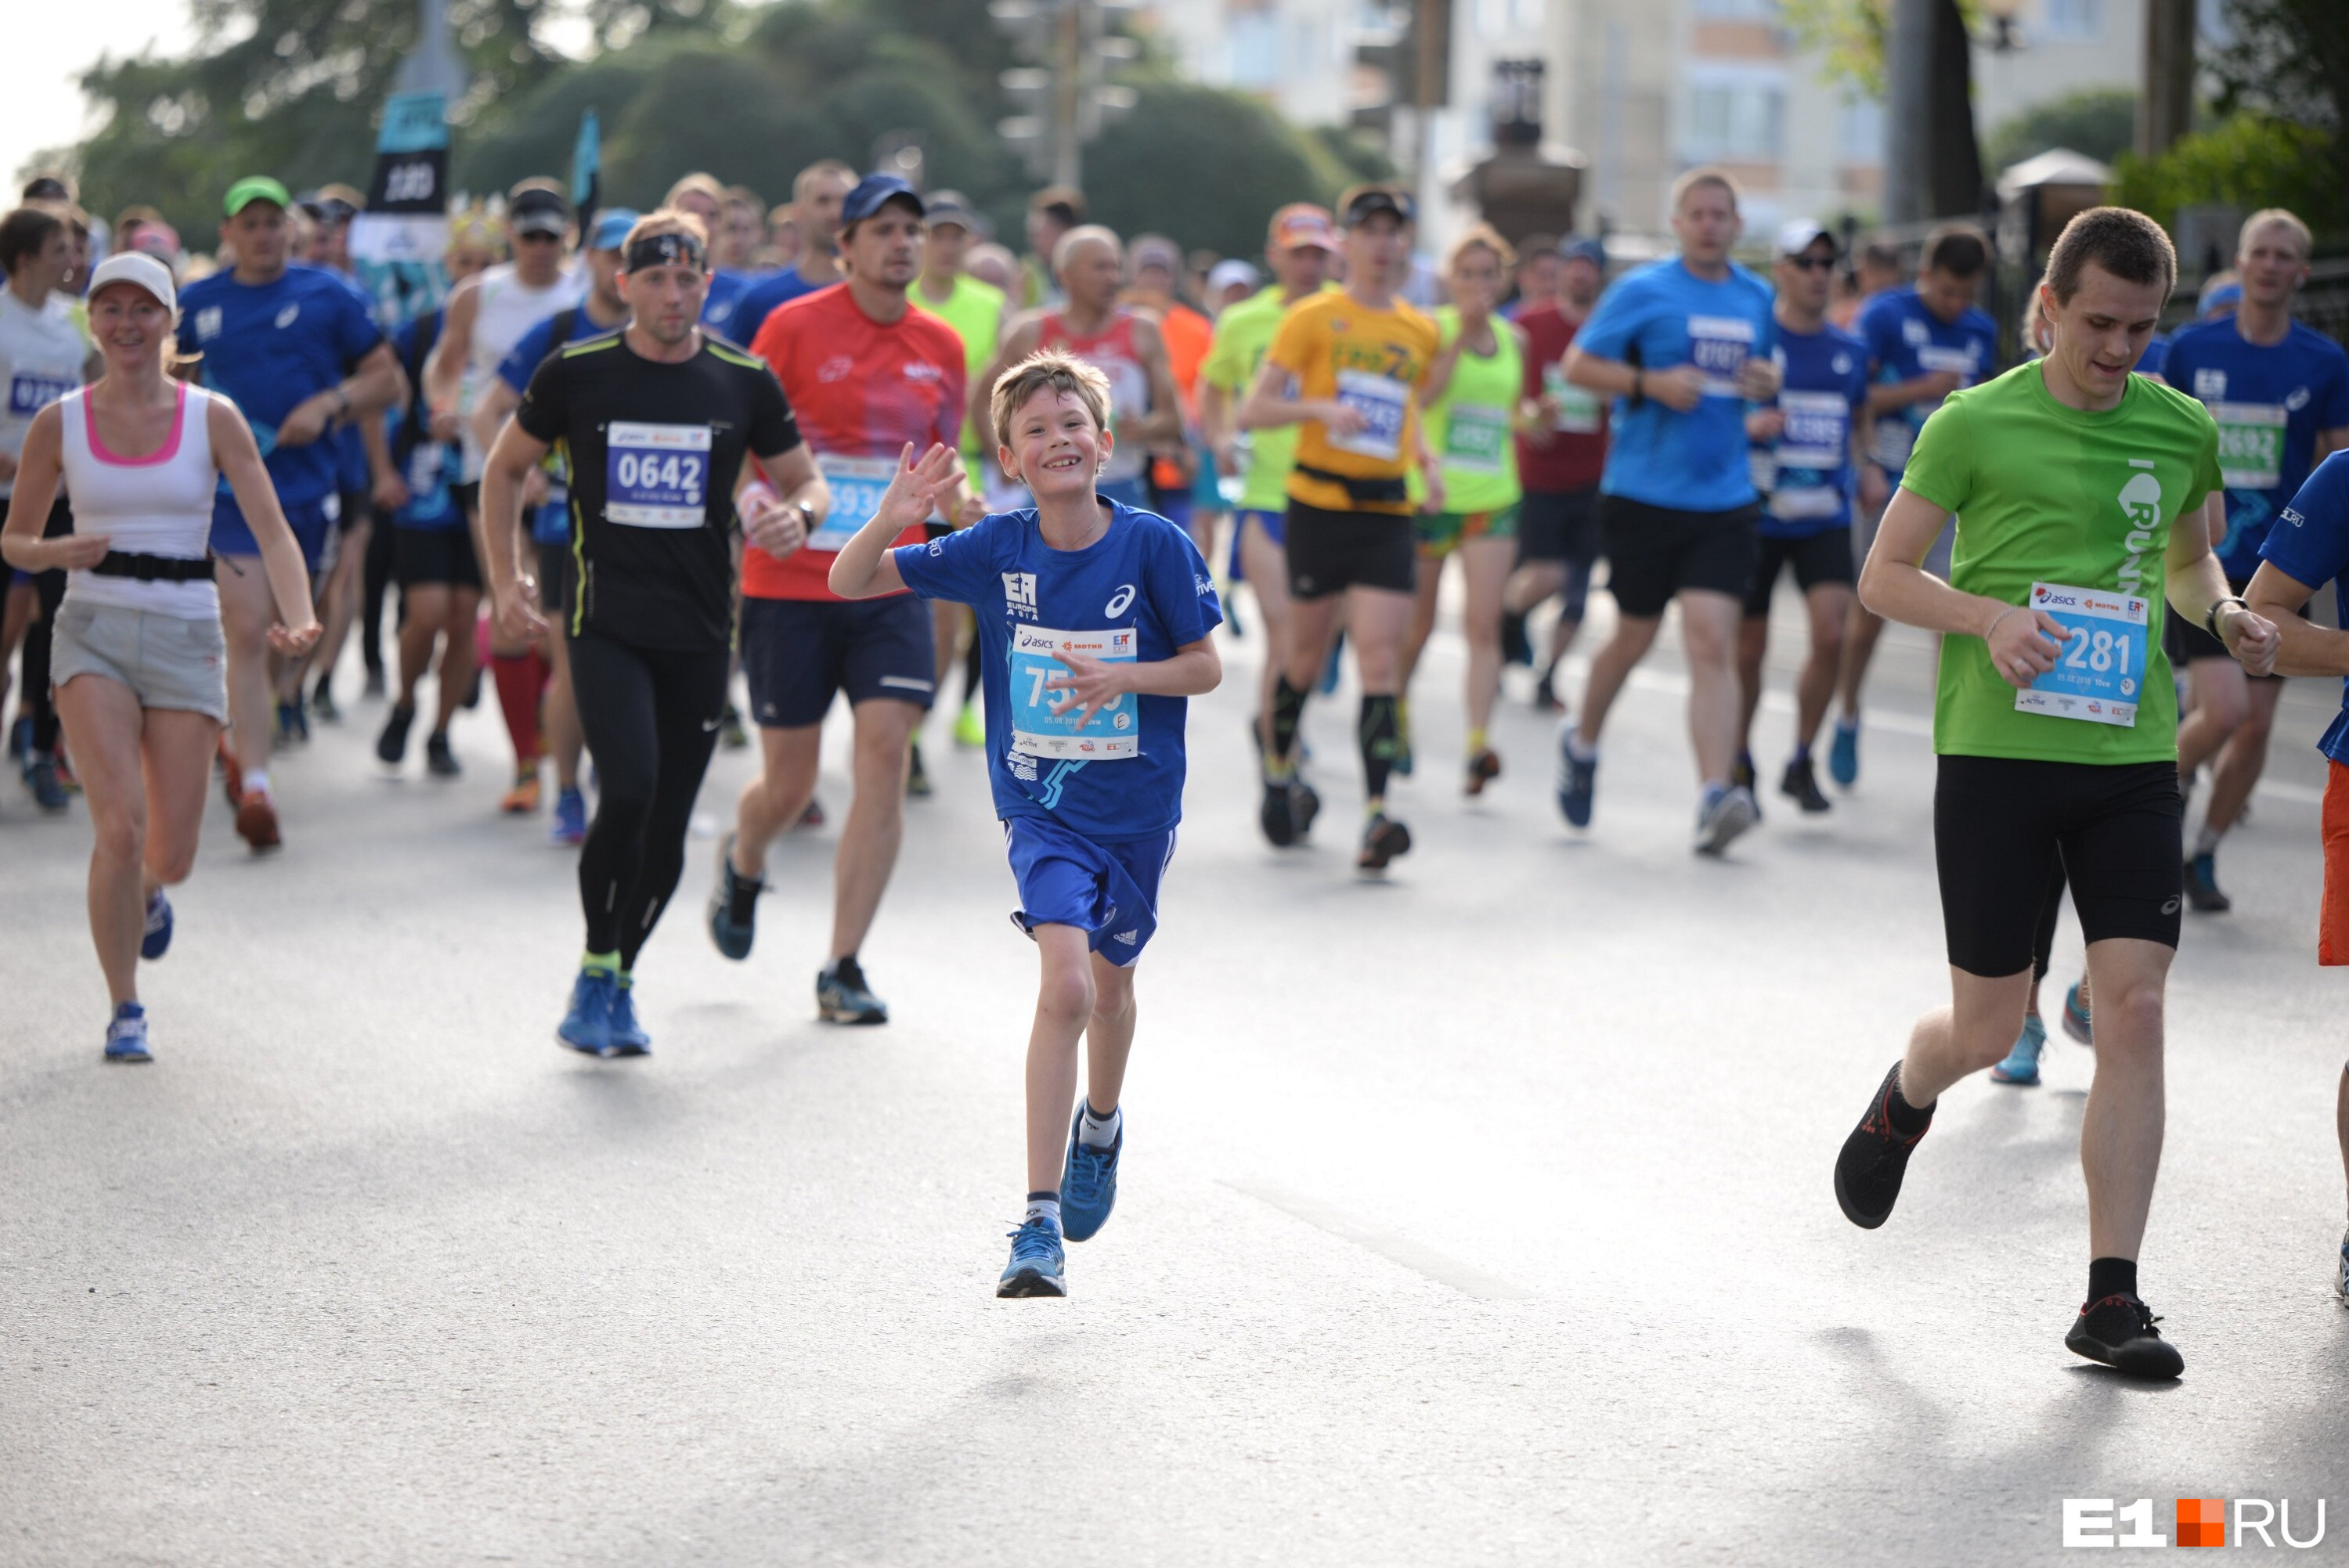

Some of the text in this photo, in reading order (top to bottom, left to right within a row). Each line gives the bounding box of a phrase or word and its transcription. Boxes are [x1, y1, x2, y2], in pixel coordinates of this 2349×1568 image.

[617, 452, 702, 491] 0642
[2051, 595, 2077, 606] asics
[1006, 601, 1037, 614] EUROPE
[1031, 638, 1054, 649] asics
[2055, 626, 2130, 675] 281
[1025, 666, 1123, 712] 75
[1023, 740, 1038, 748] ACTIVE
